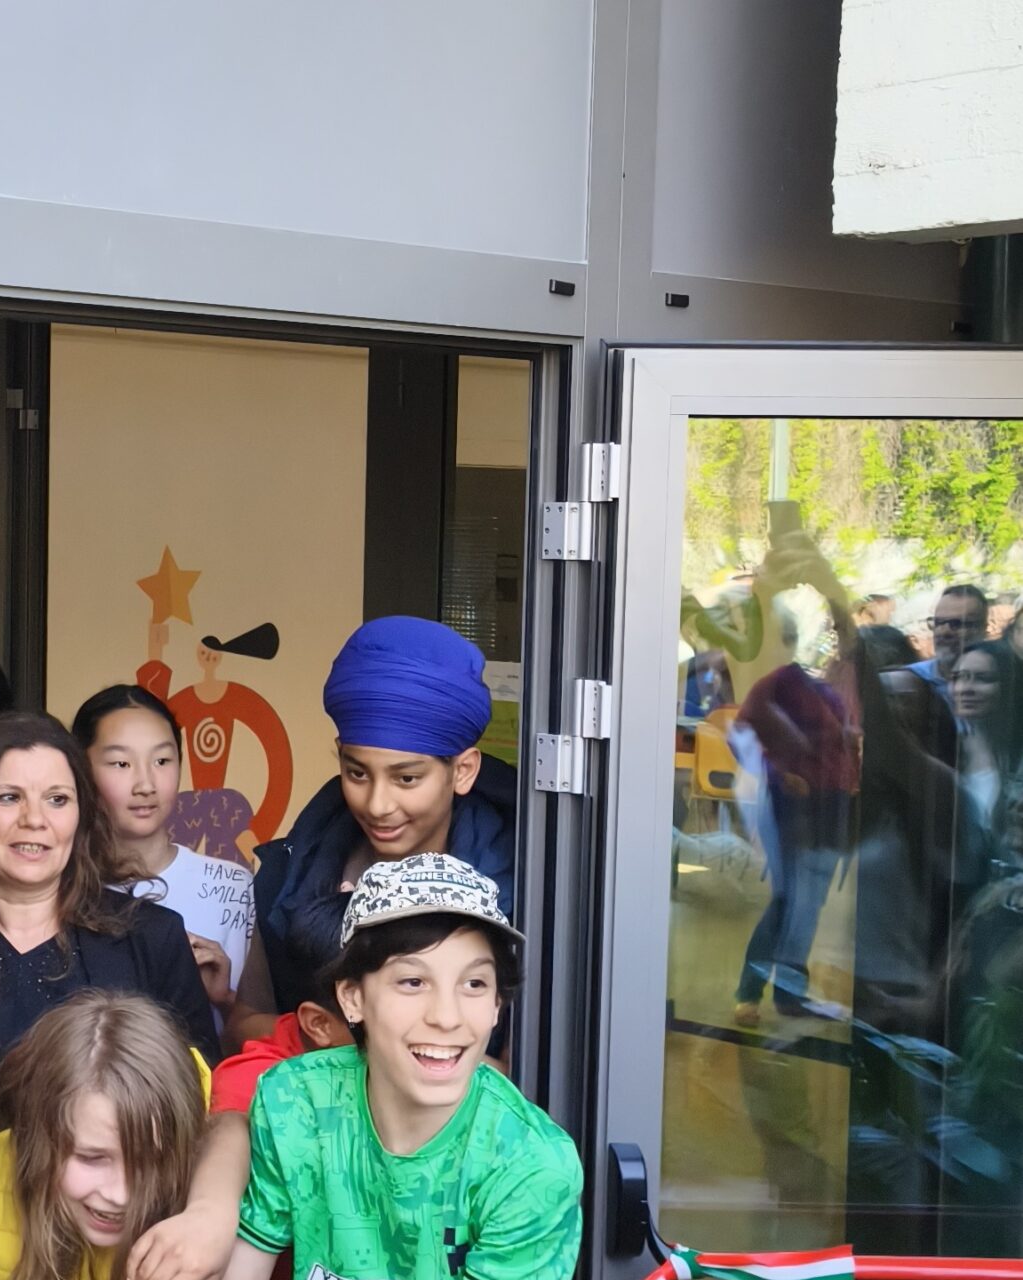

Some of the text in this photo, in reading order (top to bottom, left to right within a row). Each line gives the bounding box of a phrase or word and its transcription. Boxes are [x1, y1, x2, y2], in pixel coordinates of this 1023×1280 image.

[204, 863, 246, 881] HAVE
[400, 872, 490, 893] MINECRAFT
[219, 908, 248, 930] DAY
